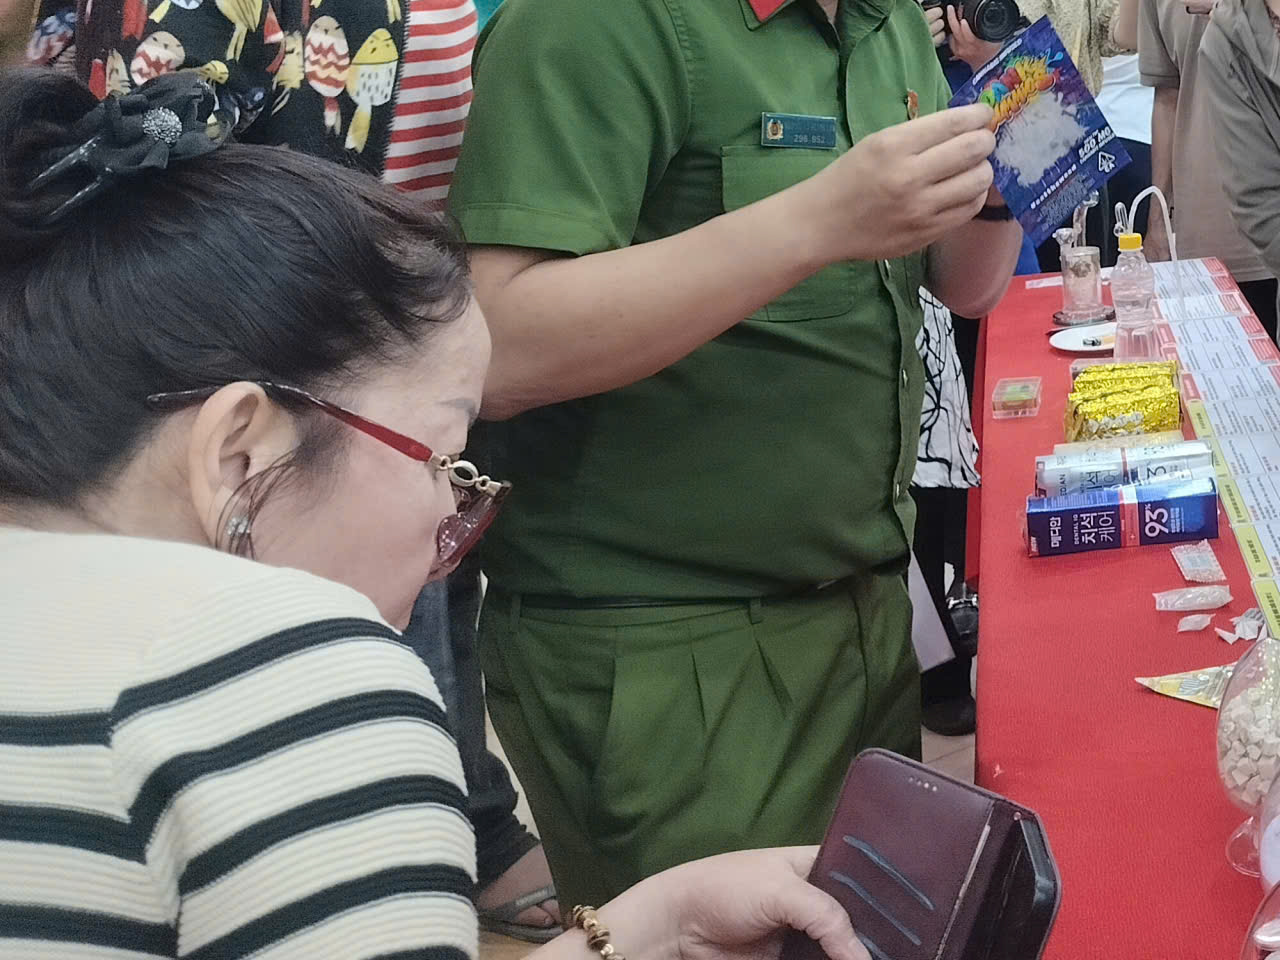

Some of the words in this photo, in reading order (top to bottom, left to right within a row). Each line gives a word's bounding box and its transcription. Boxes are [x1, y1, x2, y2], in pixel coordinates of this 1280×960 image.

[1050, 517, 1061, 546] 메디안
[1080, 513, 1097, 543] 치석
[1097, 511, 1115, 541] 케어
